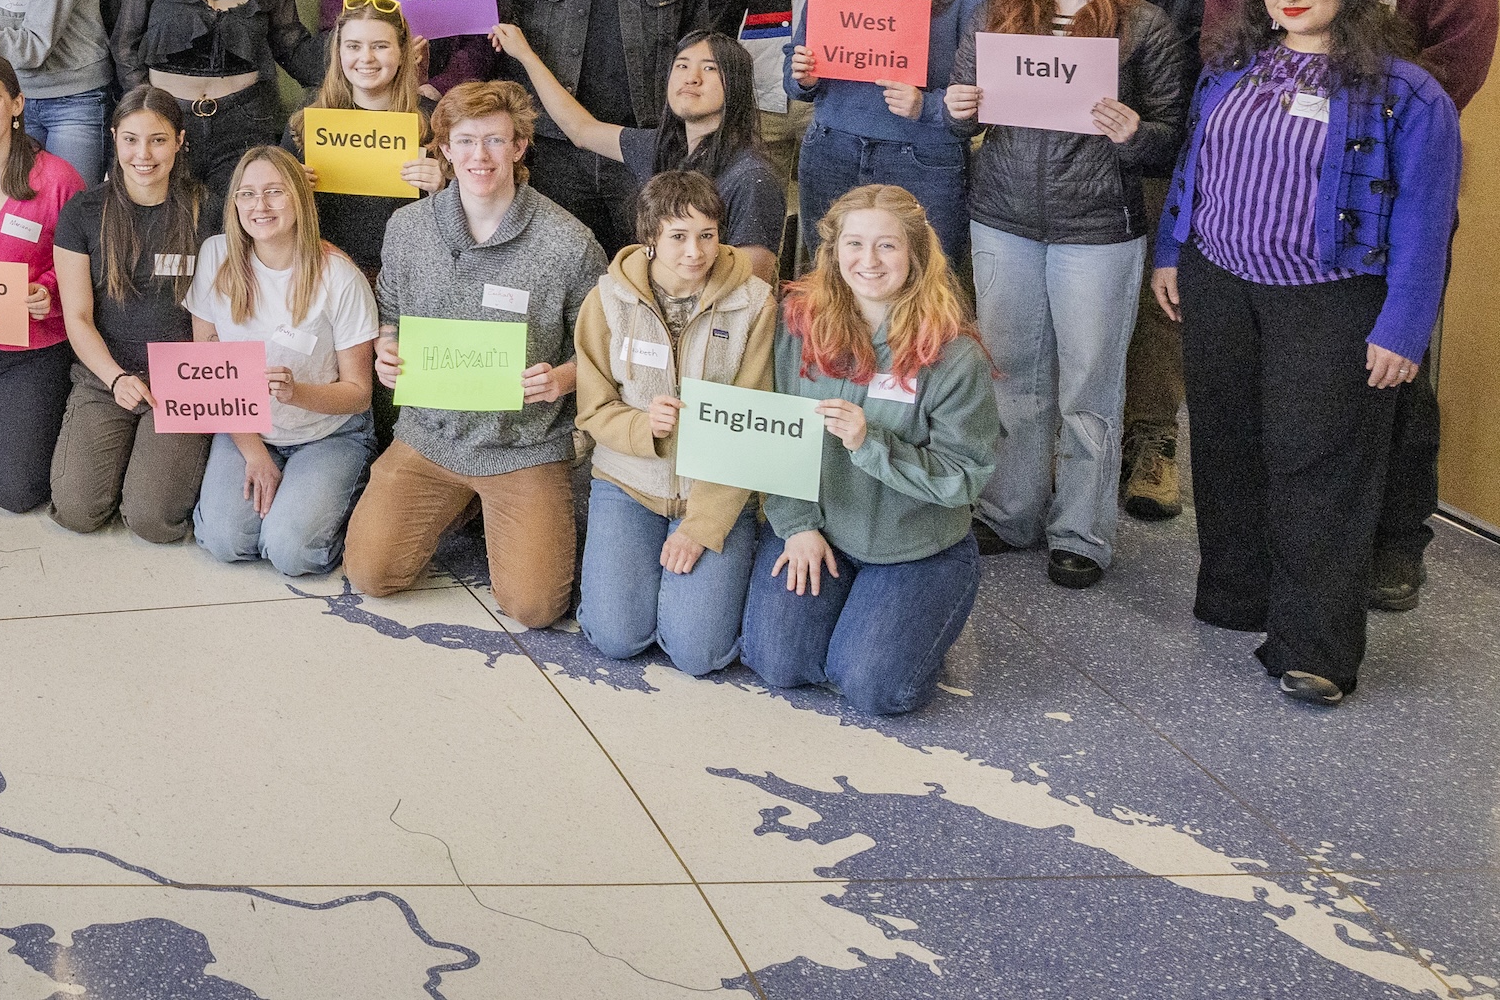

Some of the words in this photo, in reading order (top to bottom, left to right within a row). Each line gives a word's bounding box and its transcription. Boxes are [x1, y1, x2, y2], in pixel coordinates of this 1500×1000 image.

[839, 11, 897, 33] West
[823, 45, 909, 70] Virginia
[1016, 55, 1078, 84] Italy
[315, 127, 406, 150] Sweden
[177, 360, 238, 381] Czech
[165, 397, 259, 421] Republic
[699, 402, 804, 439] England
